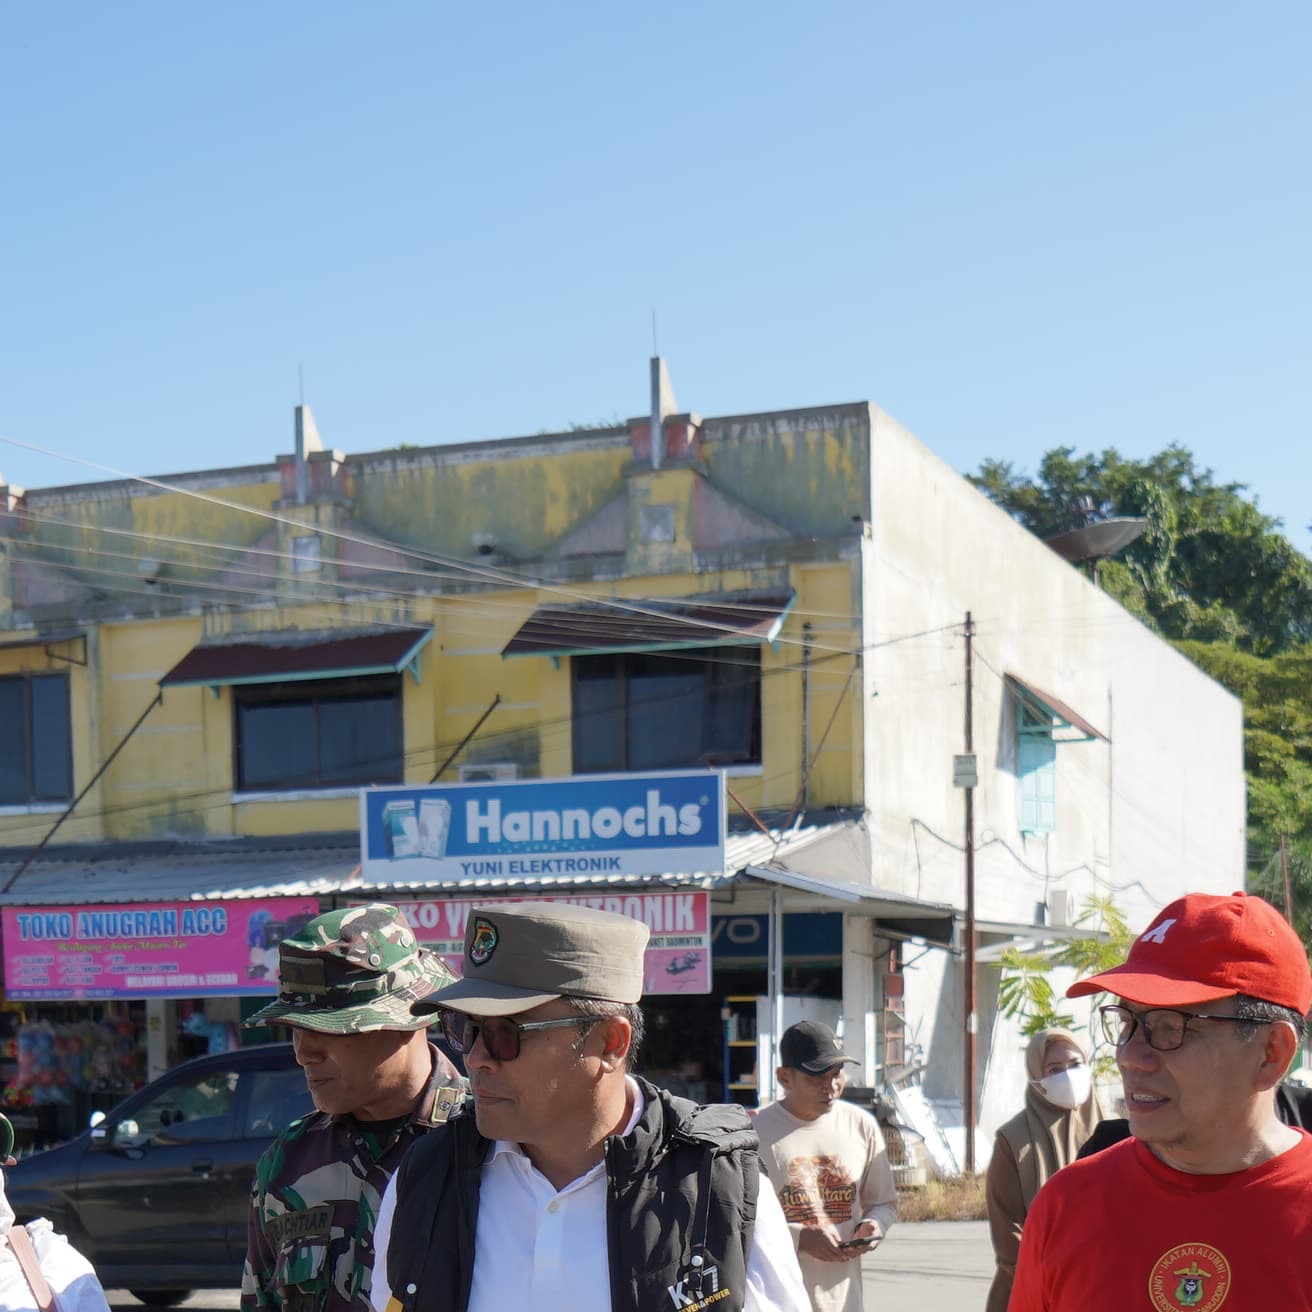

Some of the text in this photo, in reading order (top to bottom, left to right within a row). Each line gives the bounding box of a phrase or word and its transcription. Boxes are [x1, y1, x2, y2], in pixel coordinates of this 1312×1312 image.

[466, 790, 702, 843] Hannochs
[460, 856, 621, 877] YUNI ELEKTRONIK
[17, 906, 228, 941] TOKO ANUGRAH ACC
[1141, 919, 1176, 944] A
[1162, 1247, 1226, 1274] IKATAN ALUMNI
